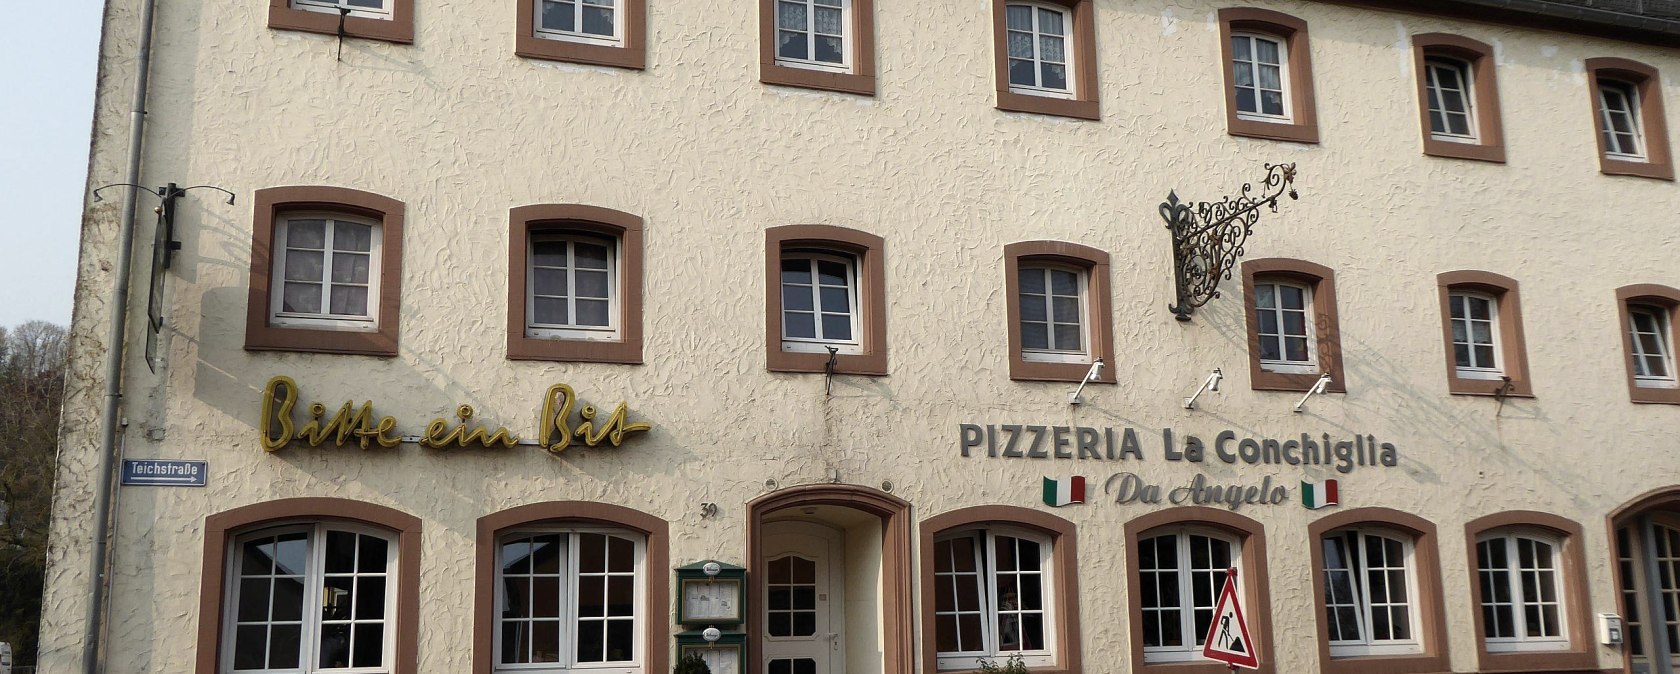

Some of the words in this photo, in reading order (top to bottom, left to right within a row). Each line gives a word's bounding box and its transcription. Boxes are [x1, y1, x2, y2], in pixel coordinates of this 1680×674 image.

[260, 375, 401, 452] Bitte
[418, 403, 518, 448] ein
[540, 383, 652, 452] Bit
[959, 423, 1143, 460] PIZZERIA
[1163, 427, 1203, 462] La
[1215, 430, 1397, 473] Conchiglia
[132, 461, 198, 475] Teichstraße
[700, 502, 718, 519] 39
[1105, 472, 1162, 505] Da
[1168, 474, 1290, 511] Angelo
